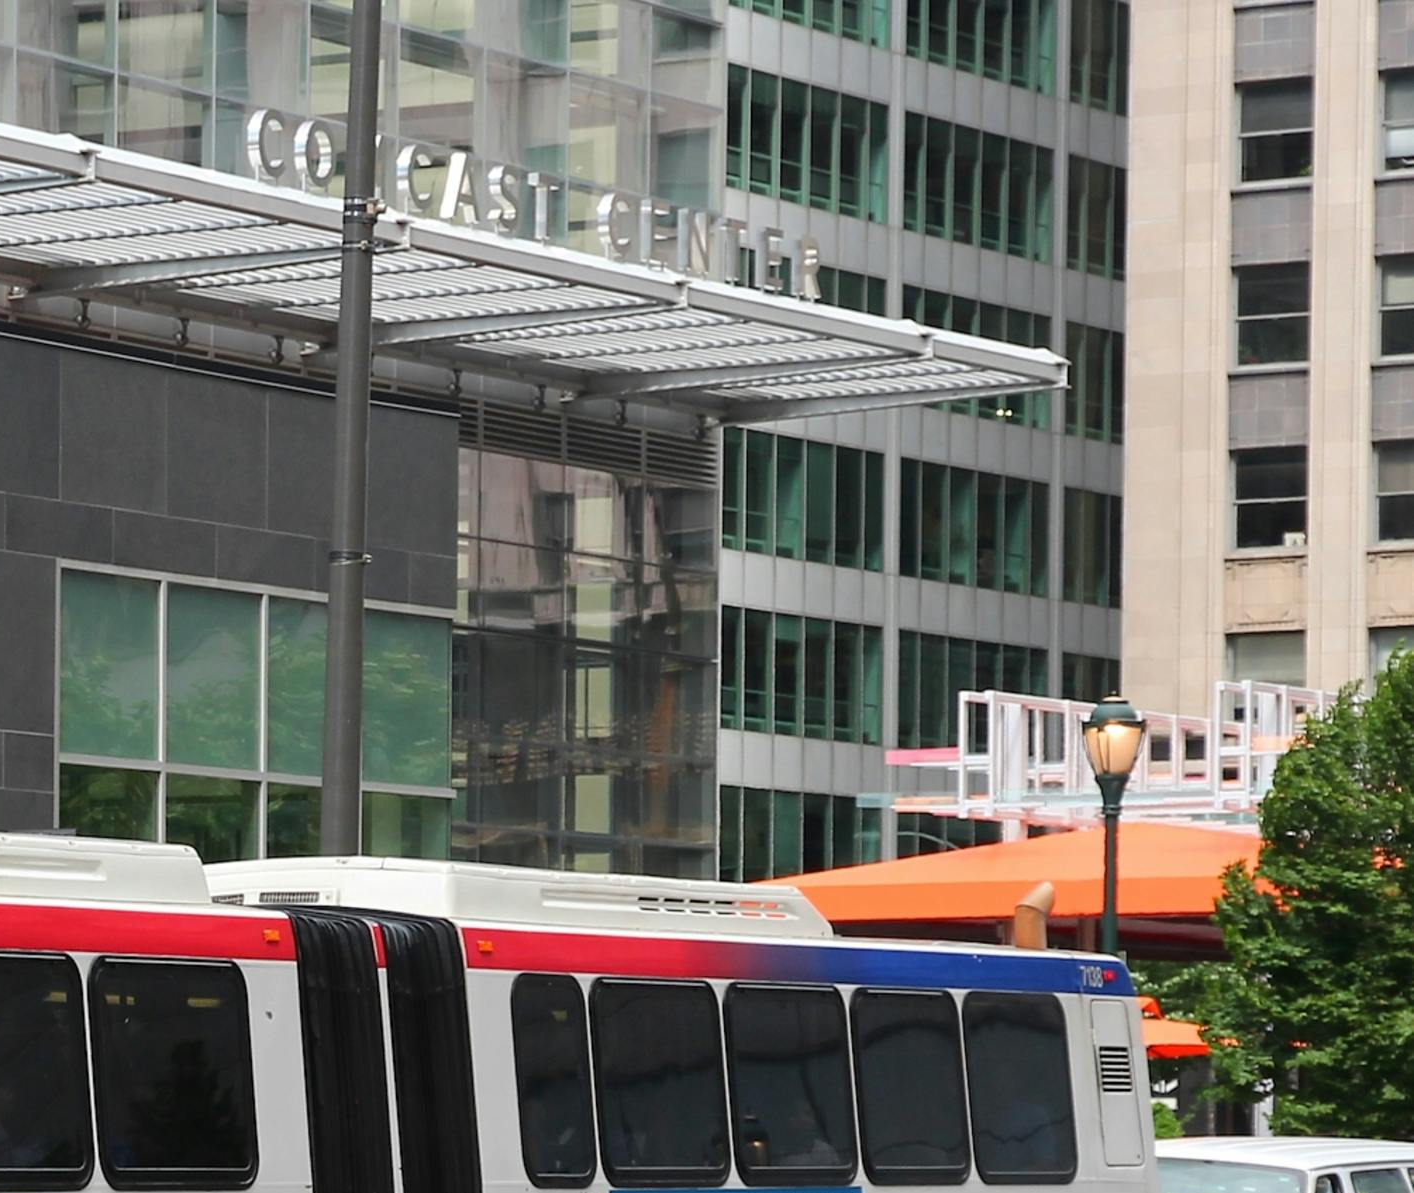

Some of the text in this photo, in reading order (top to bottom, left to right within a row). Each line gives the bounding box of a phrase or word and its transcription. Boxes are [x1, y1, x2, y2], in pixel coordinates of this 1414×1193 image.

[247, 107, 822, 300] COCAST CENTER
[1080, 966, 1103, 988] 7138
